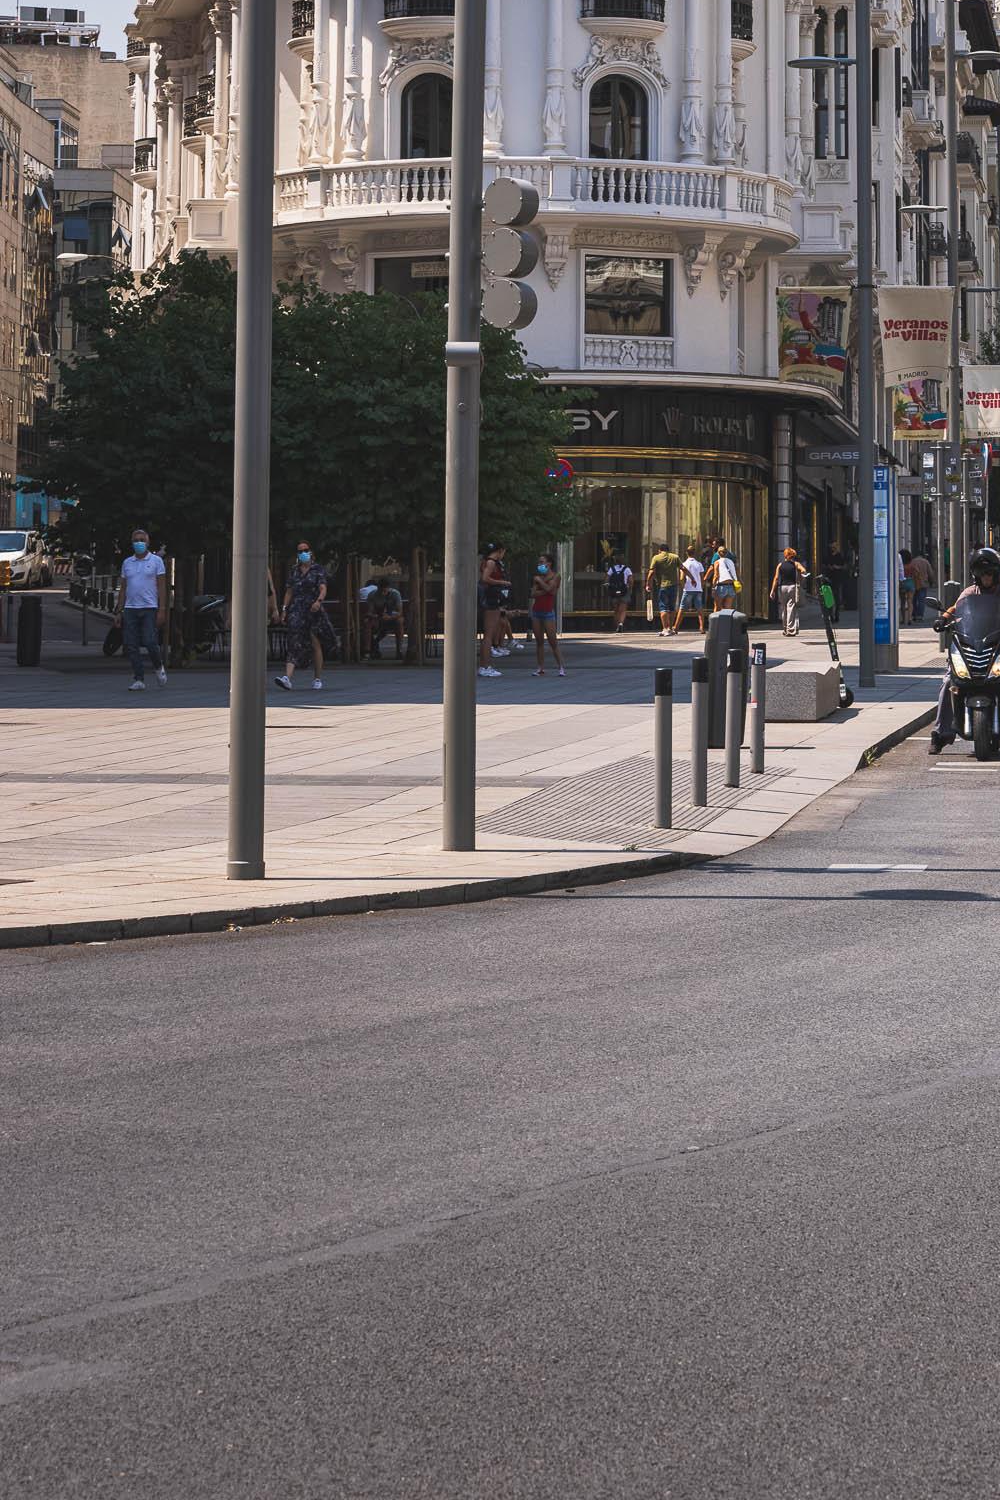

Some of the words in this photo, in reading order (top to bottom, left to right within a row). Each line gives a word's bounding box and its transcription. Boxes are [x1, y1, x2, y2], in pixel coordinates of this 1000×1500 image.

[884, 319, 949, 331] Veranos
[900, 330, 938, 341] Villa
[904, 370, 929, 378] MADRID
